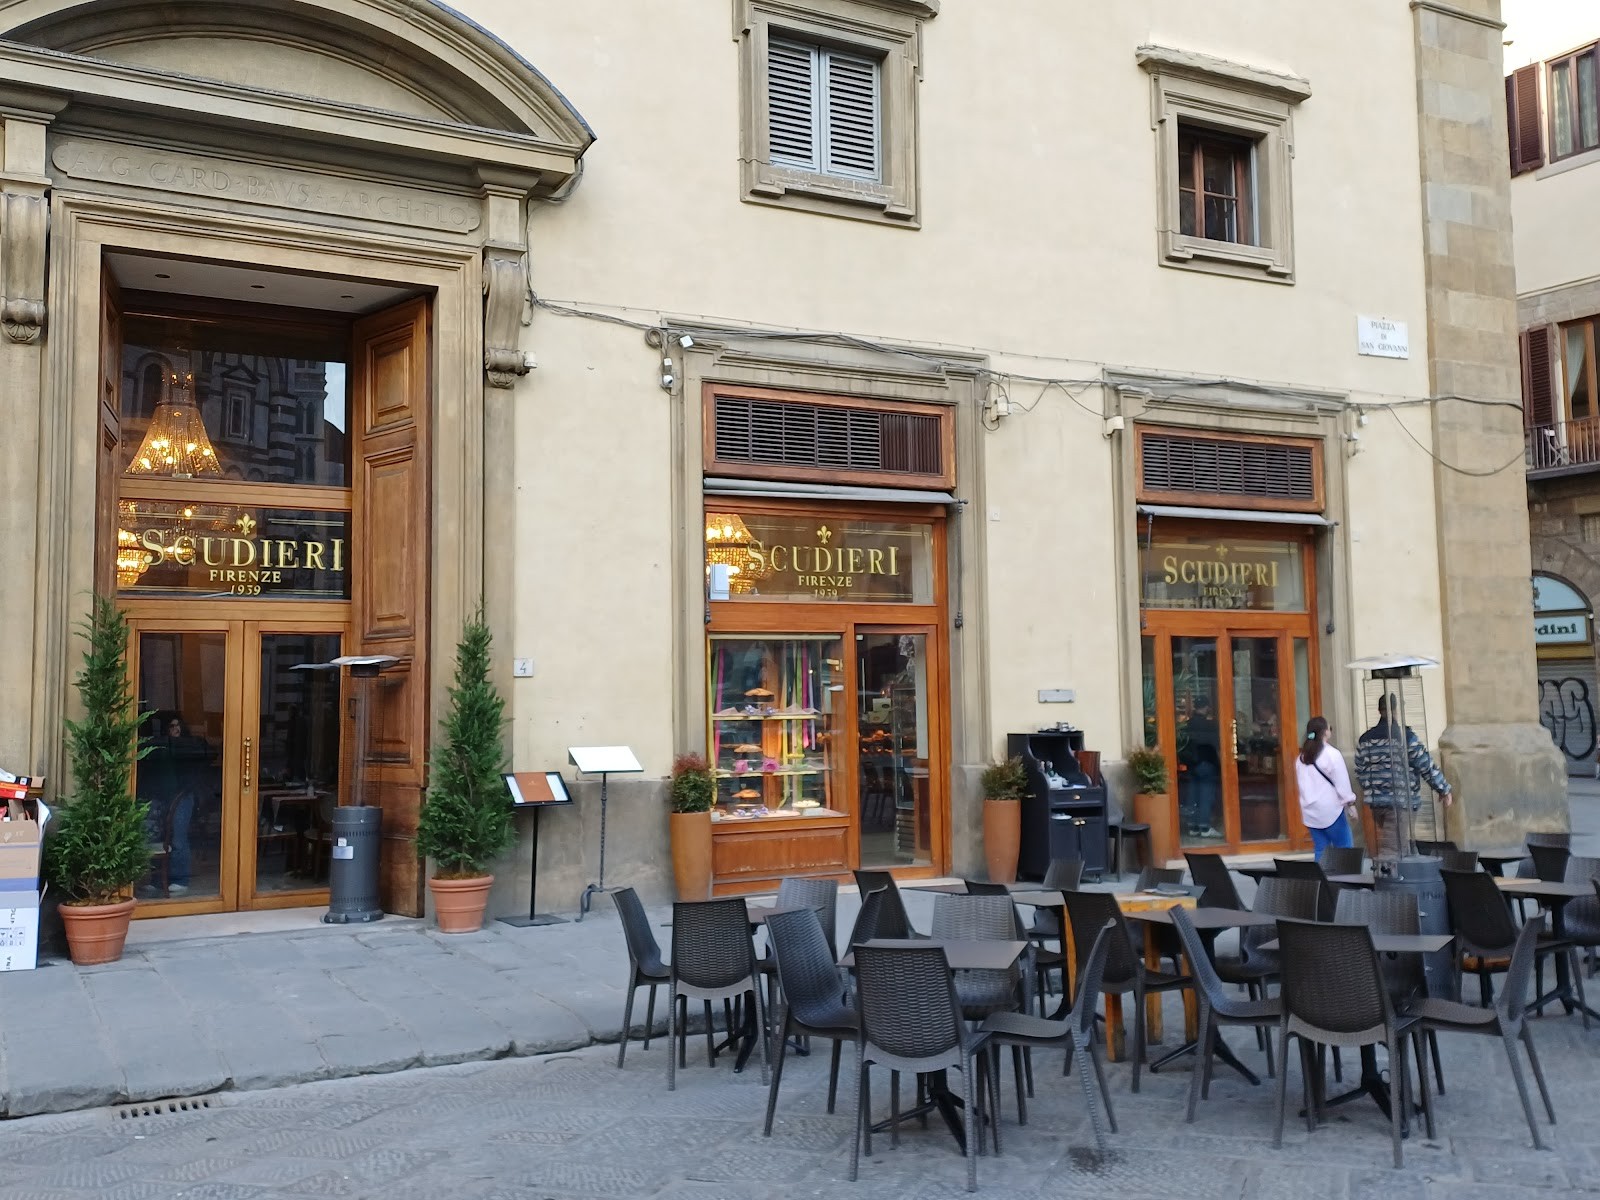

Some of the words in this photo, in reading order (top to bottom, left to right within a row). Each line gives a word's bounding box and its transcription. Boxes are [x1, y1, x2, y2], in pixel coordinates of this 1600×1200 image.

[150, 162, 230, 191] CARD
[339, 191, 412, 222] ARCH
[423, 202, 468, 226] FLO
[1371, 321, 1395, 331] PIAZZA
[142, 529, 344, 571] SCUDIERI
[748, 539, 900, 576] SCUDIERI
[209, 569, 282, 584] FIRENZE
[1163, 555, 1279, 587] SCUDIERI
[798, 575, 853, 587] FIRENZE
[1535, 623, 1578, 635] dini
[519, 662, 526, 674] 4
